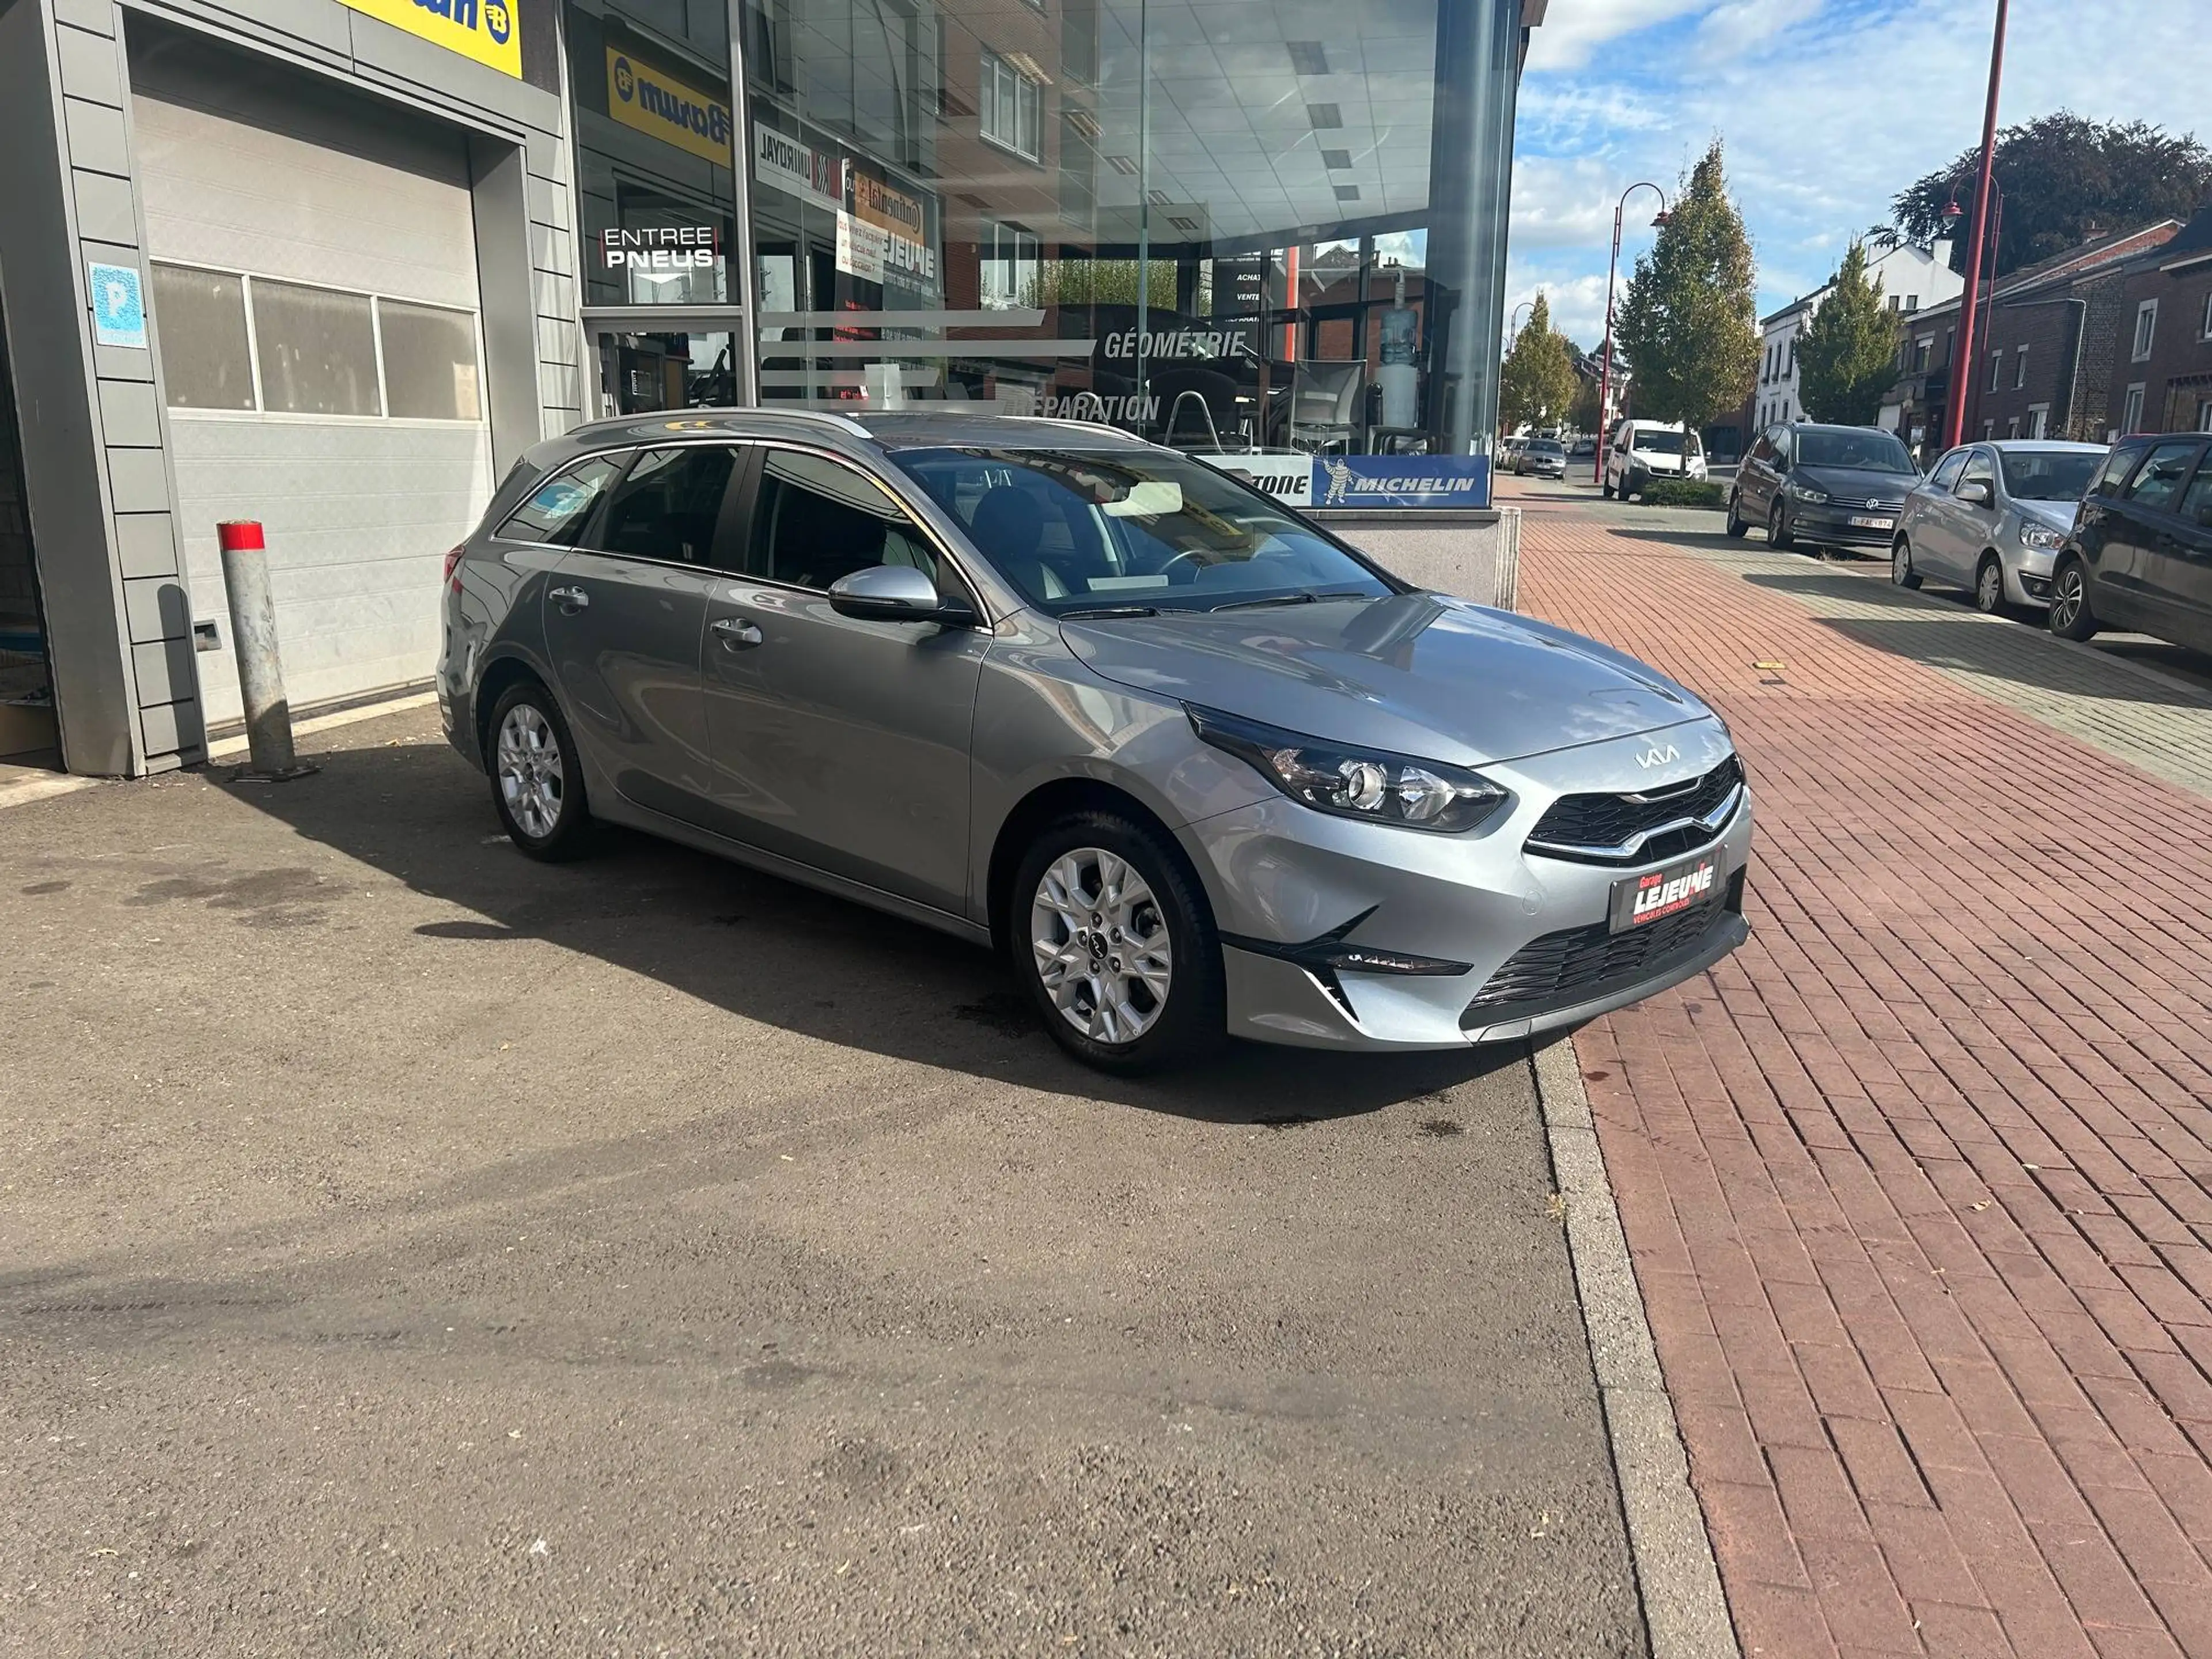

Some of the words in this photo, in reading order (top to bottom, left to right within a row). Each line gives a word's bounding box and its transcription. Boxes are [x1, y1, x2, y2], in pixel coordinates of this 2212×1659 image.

[605, 227, 712, 246] ENTREE
[607, 249, 713, 268] PNEUS
[1104, 327, 1247, 358] GÉOMÉTRIE
[1252, 475, 1309, 494] TONE
[1354, 477, 1475, 491] MICHELIN
[1633, 865, 1714, 915] LEJEUNE
